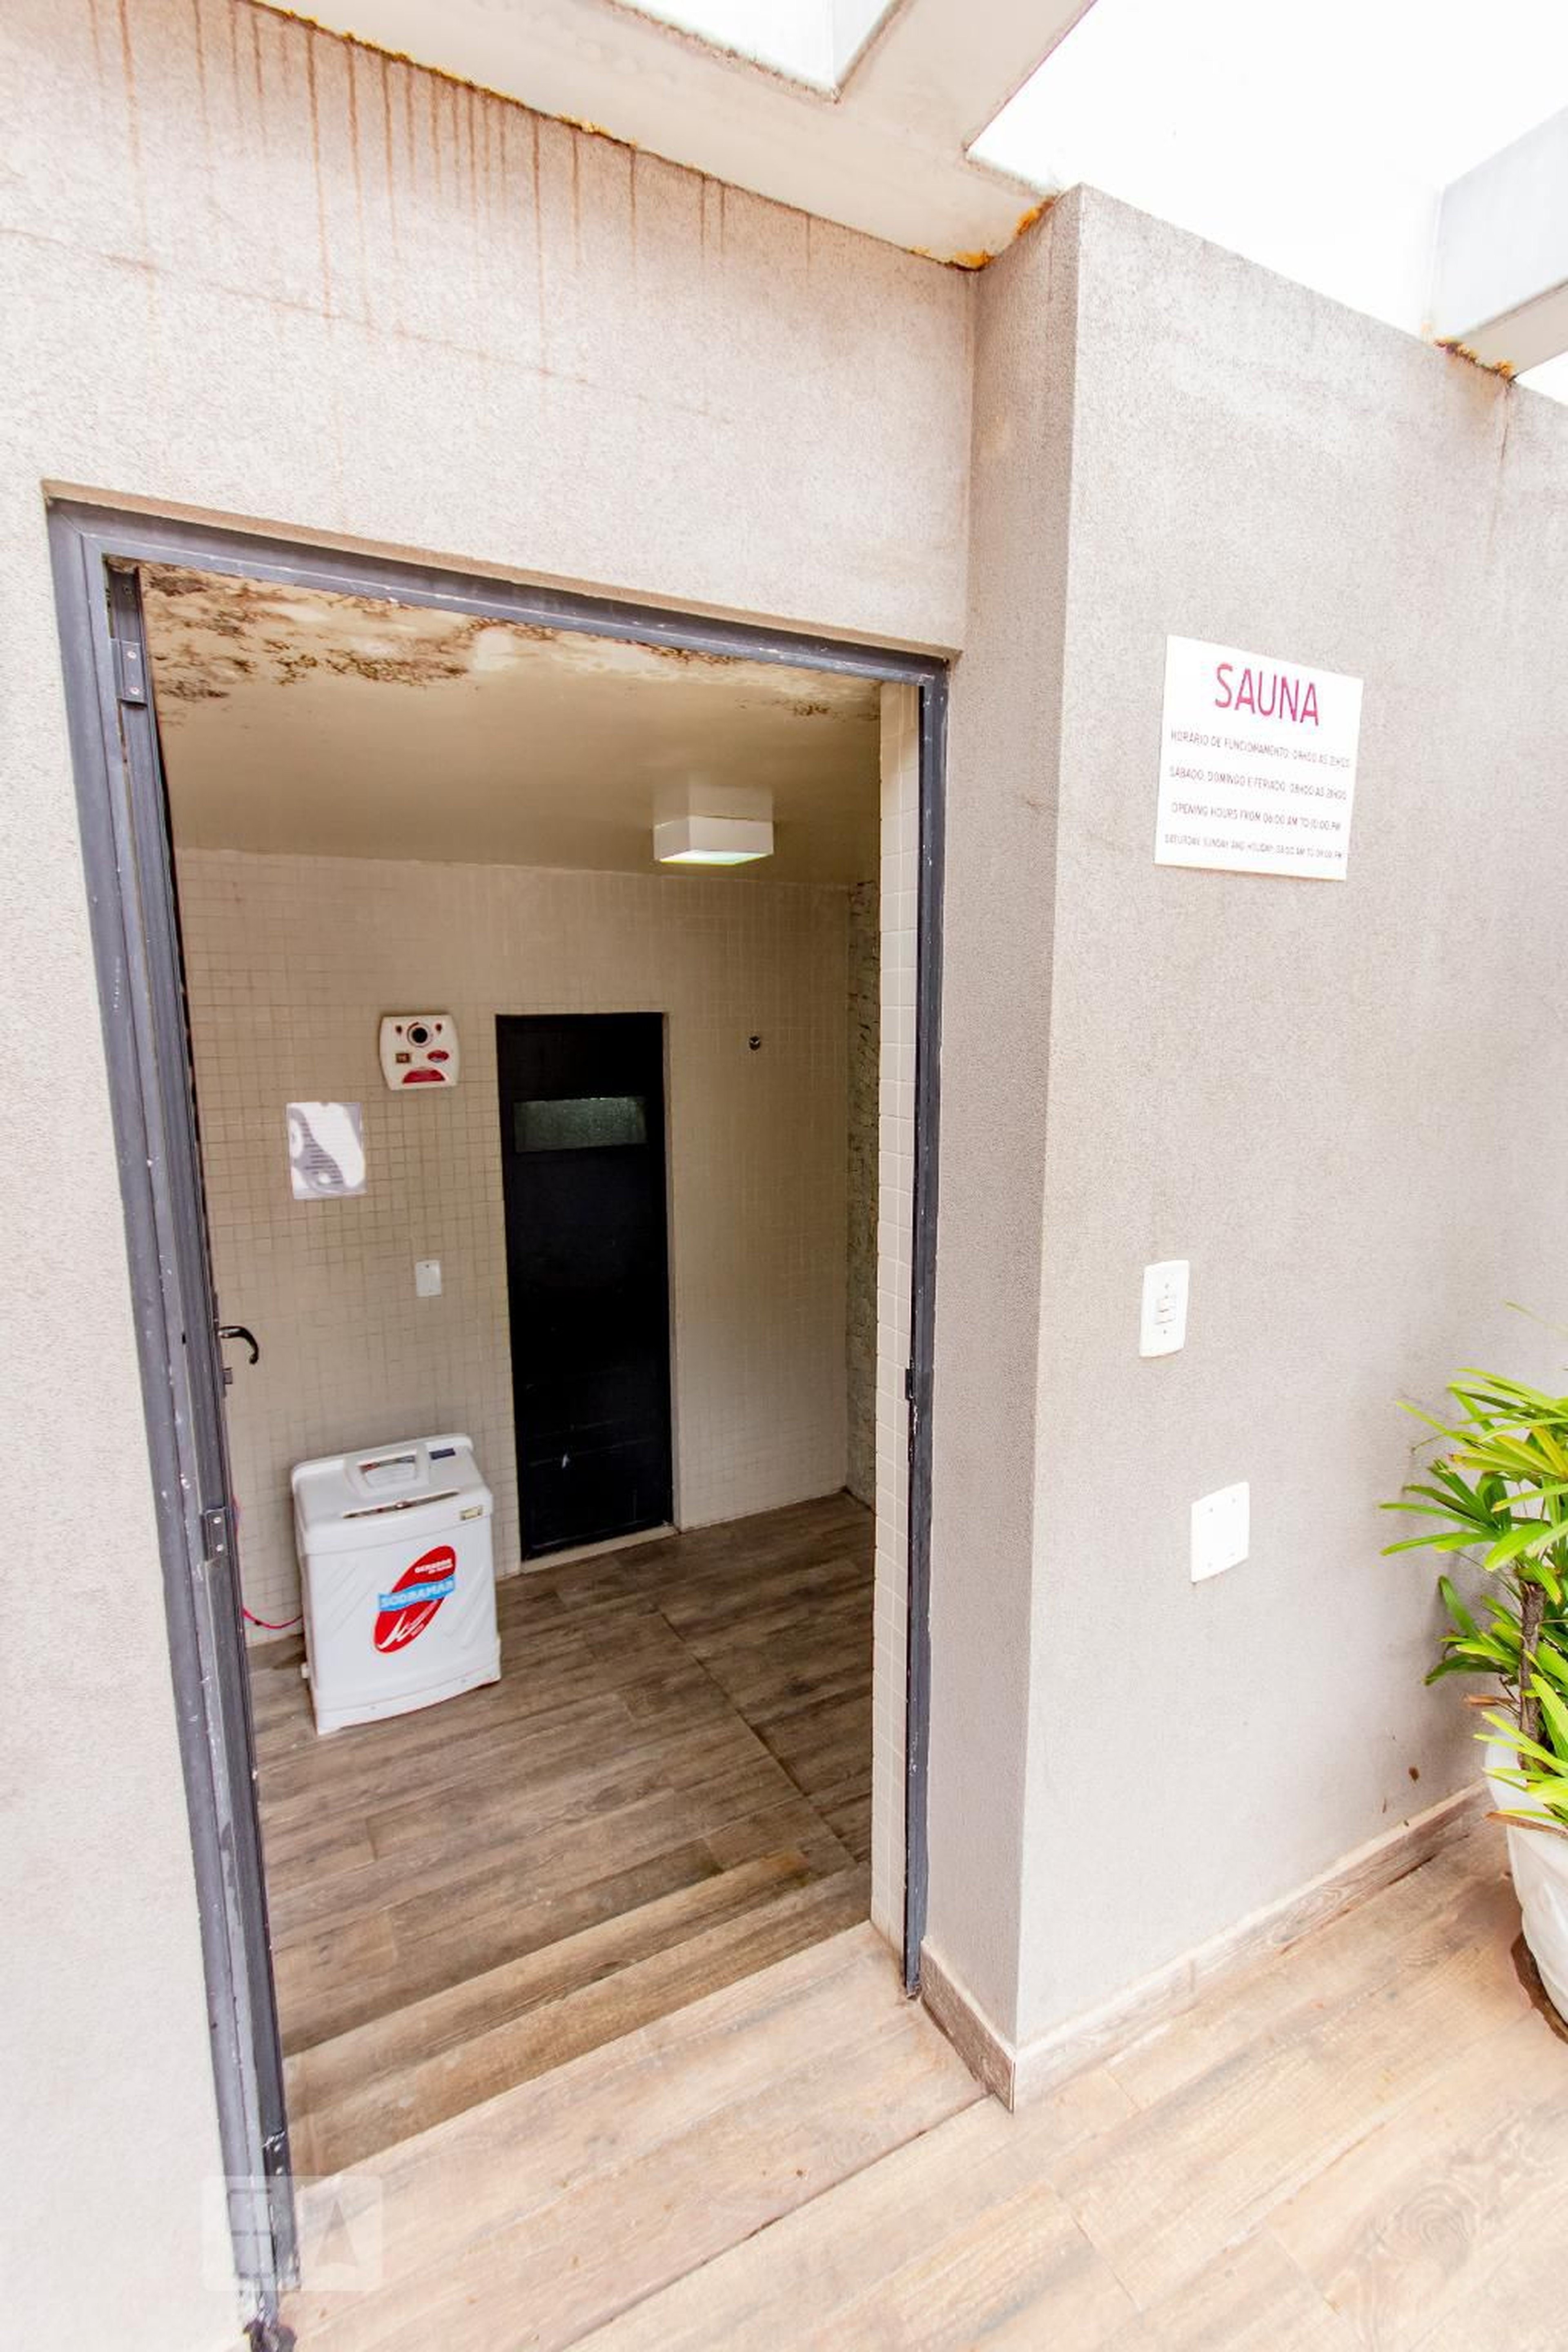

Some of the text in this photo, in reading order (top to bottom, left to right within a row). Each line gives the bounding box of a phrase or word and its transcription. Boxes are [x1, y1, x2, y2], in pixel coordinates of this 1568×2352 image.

[1215, 662, 1319, 726] SAUNA
[1171, 801, 1208, 817] OPENING
[1210, 806, 1238, 820] HOURS
[1240, 809, 1261, 822] FROM
[1287, 815, 1298, 825] AM
